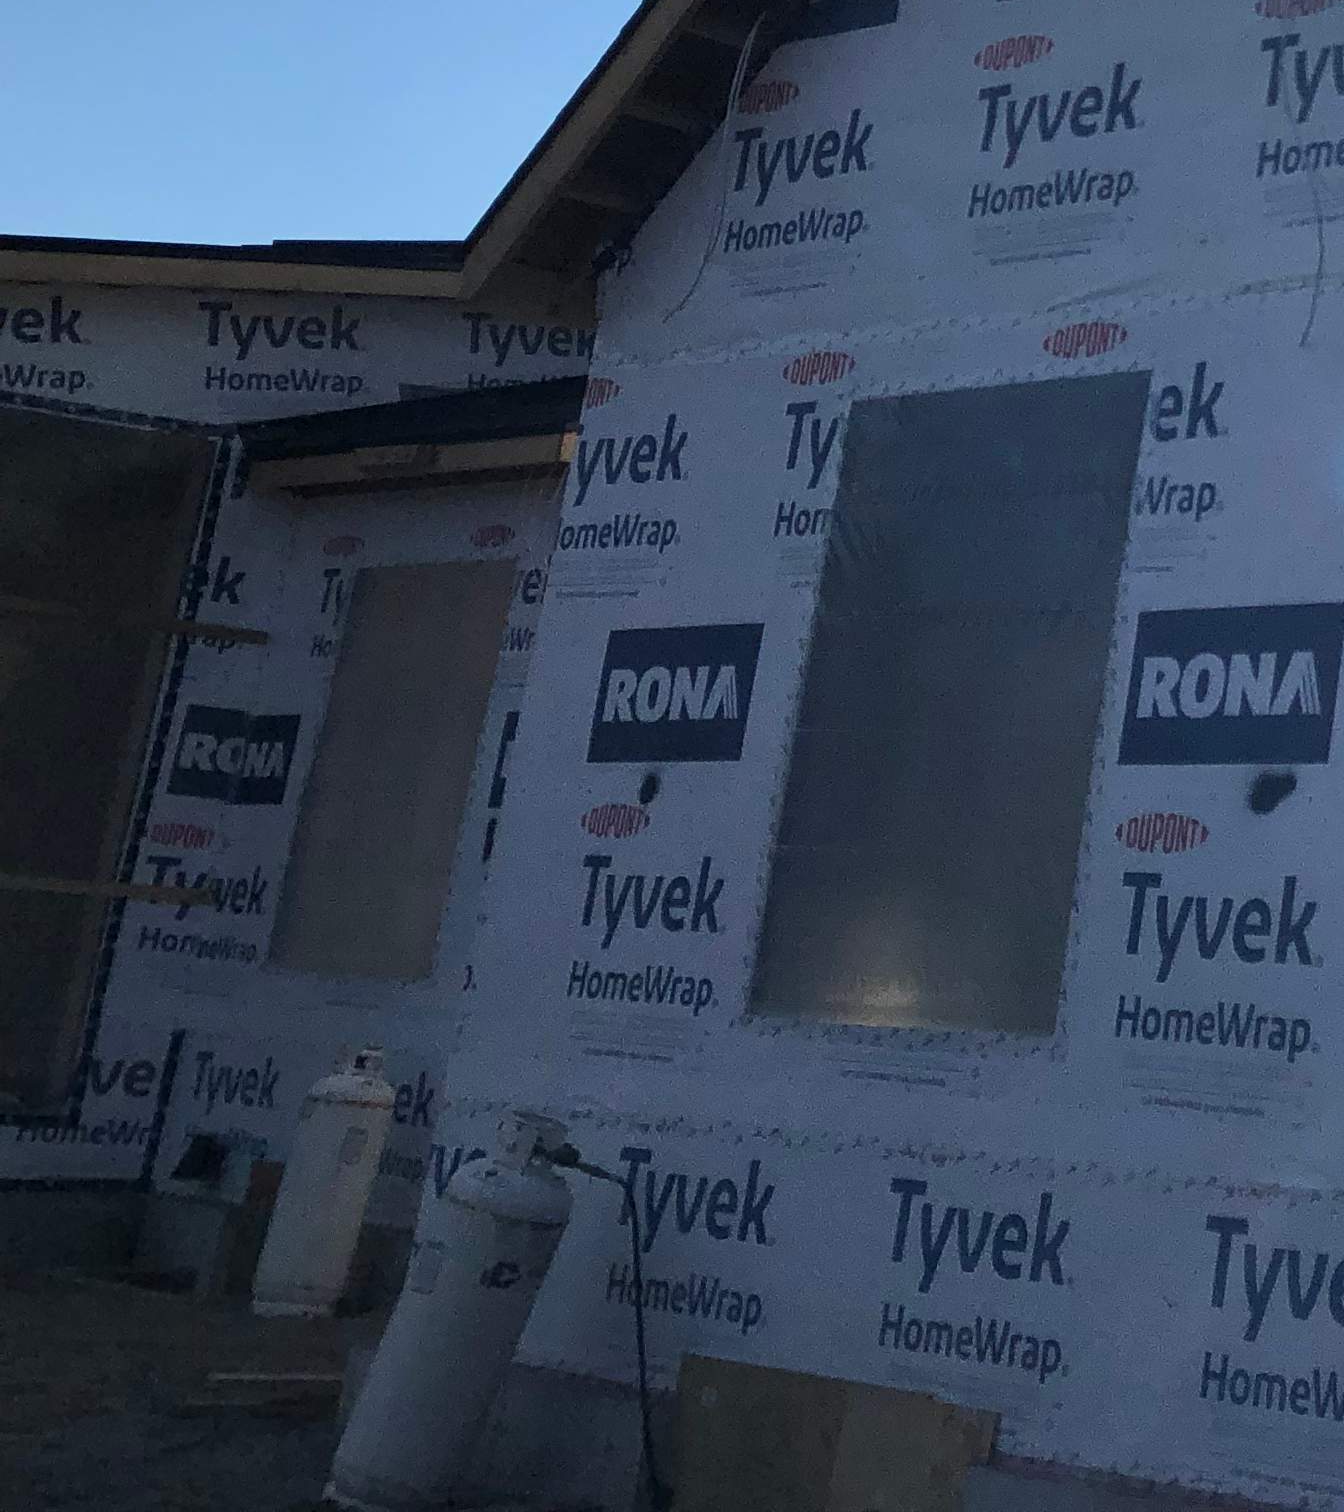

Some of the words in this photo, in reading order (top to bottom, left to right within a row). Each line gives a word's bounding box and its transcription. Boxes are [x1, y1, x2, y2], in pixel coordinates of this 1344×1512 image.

[978, 63, 1141, 168] Tyvek
[734, 109, 873, 206] Tyvek
[967, 169, 1134, 218] HomeWrap
[723, 208, 863, 253] HomeWrap
[199, 300, 360, 361] Tyvek
[205, 366, 363, 396] HomeWrap
[575, 414, 688, 506] yvek
[602, 666, 738, 724] RONA
[1136, 651, 1320, 719] RONA
[1122, 813, 1203, 854] DUPONT
[580, 855, 724, 948] Tyvek
[1121, 872, 1317, 983] Tyvek
[566, 961, 713, 1015] HomeWrap
[1115, 995, 1312, 1062] HomeWrap
[617, 1146, 775, 1253] Tyvek
[890, 1177, 1069, 1293] Tyvek
[605, 1264, 763, 1337] HomeWrap
[879, 1303, 1062, 1384] HomeWrap
